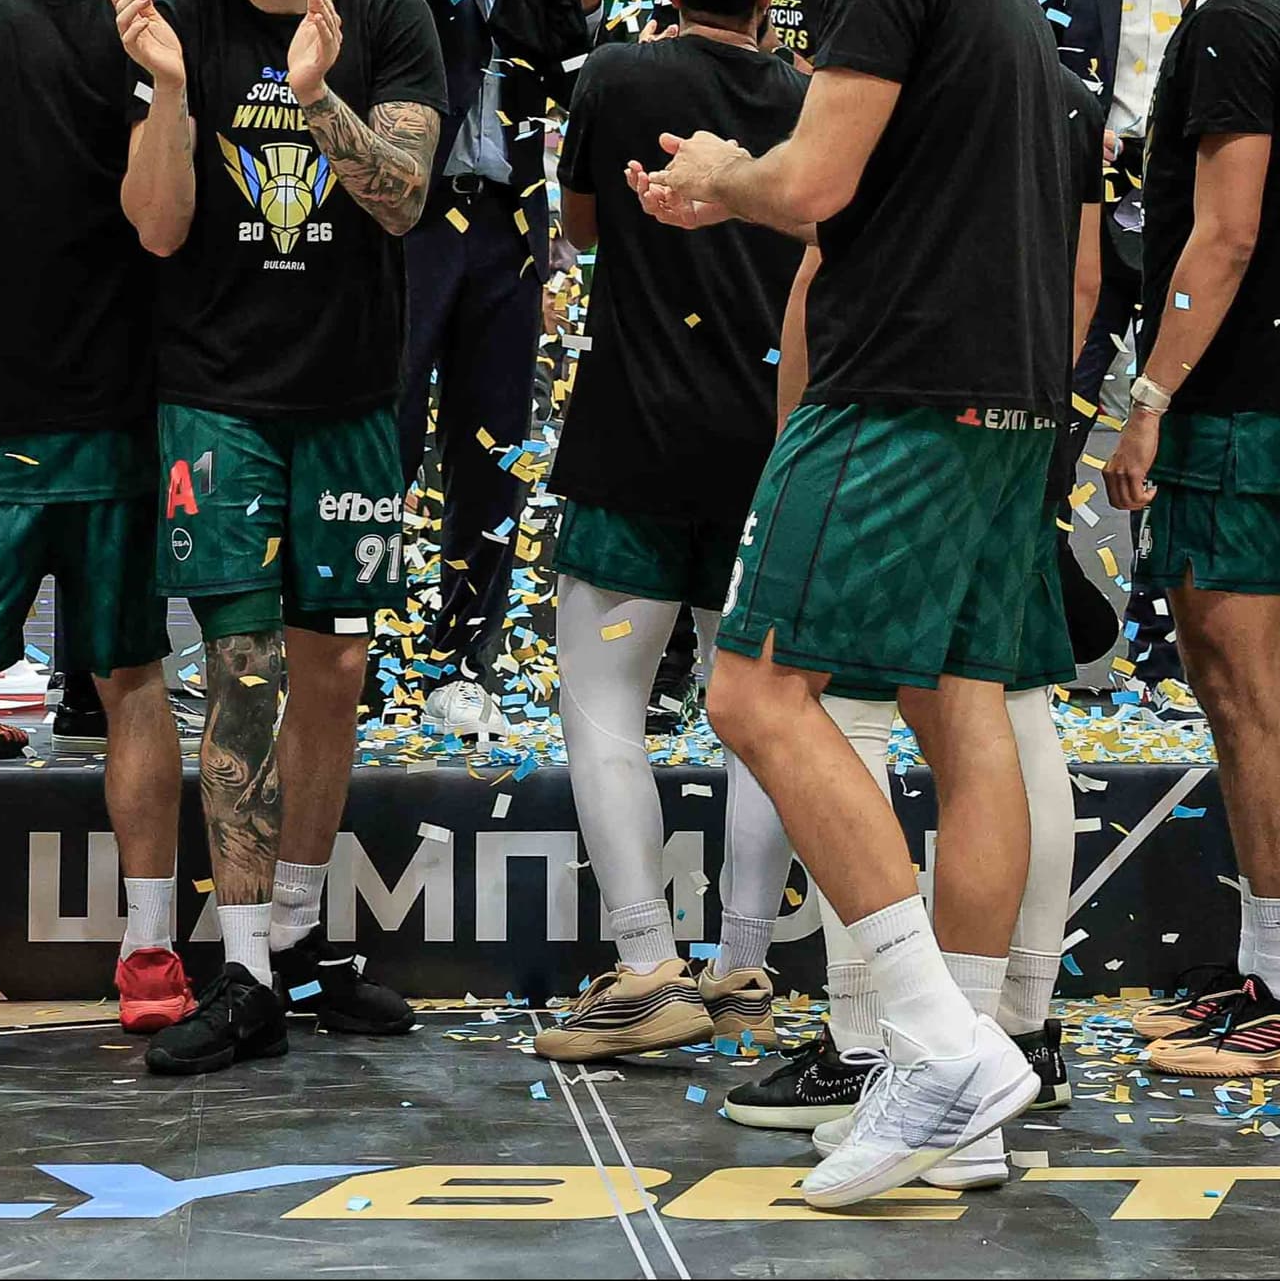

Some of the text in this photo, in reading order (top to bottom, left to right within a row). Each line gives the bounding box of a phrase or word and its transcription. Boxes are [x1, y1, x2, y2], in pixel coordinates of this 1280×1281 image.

[770, 8, 804, 26] RCUP
[246, 82, 299, 105] SUPER
[232, 104, 310, 132] WINNE
[238, 221, 333, 243] 20 26
[263, 260, 306, 271] BULGARIA
[166, 450, 213, 519] A1
[319, 489, 403, 523] efbet
[355, 534, 403, 584] 91
